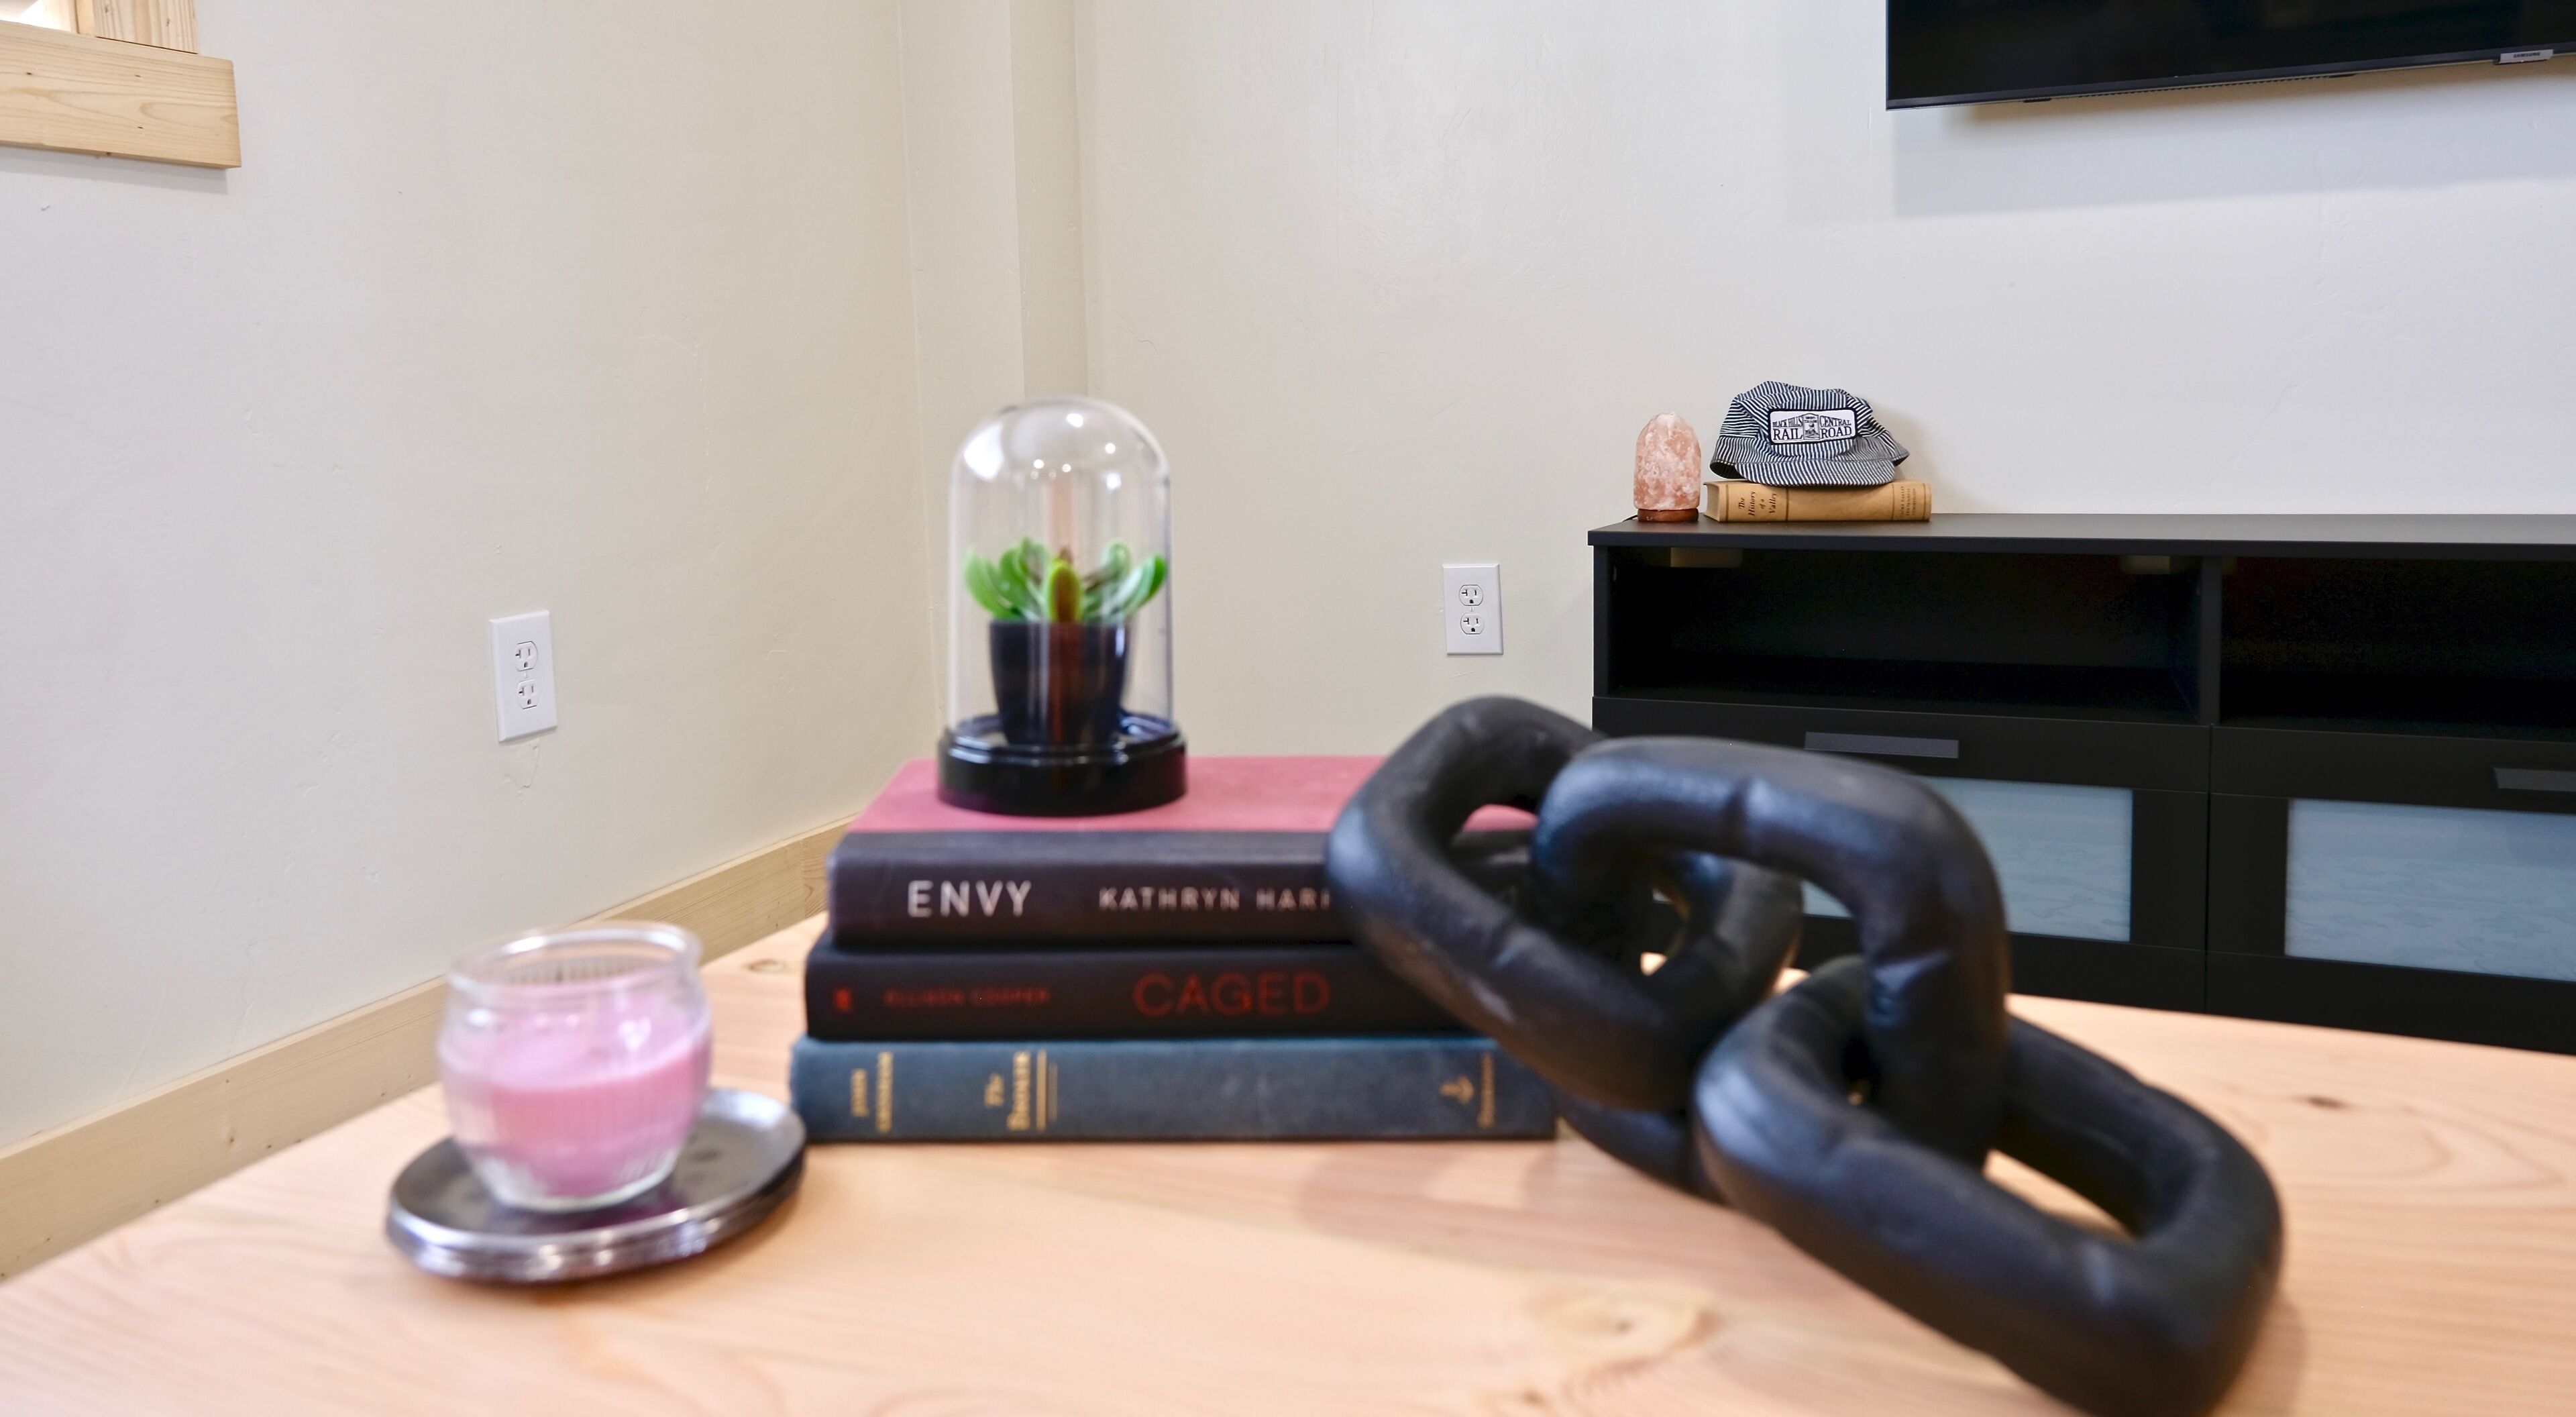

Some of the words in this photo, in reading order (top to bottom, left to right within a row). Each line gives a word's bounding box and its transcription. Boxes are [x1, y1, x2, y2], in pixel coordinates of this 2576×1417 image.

[1773, 428, 1803, 440] RAIL
[1820, 425, 1852, 439] ROAD
[1819, 415, 1851, 427] CENTRAL
[1748, 491, 1756, 516] History
[1769, 492, 1778, 513] Valley
[907, 880, 1032, 917] ENVY
[1099, 887, 1240, 911] KATHRYN
[1134, 970, 1331, 1017] CAGED
